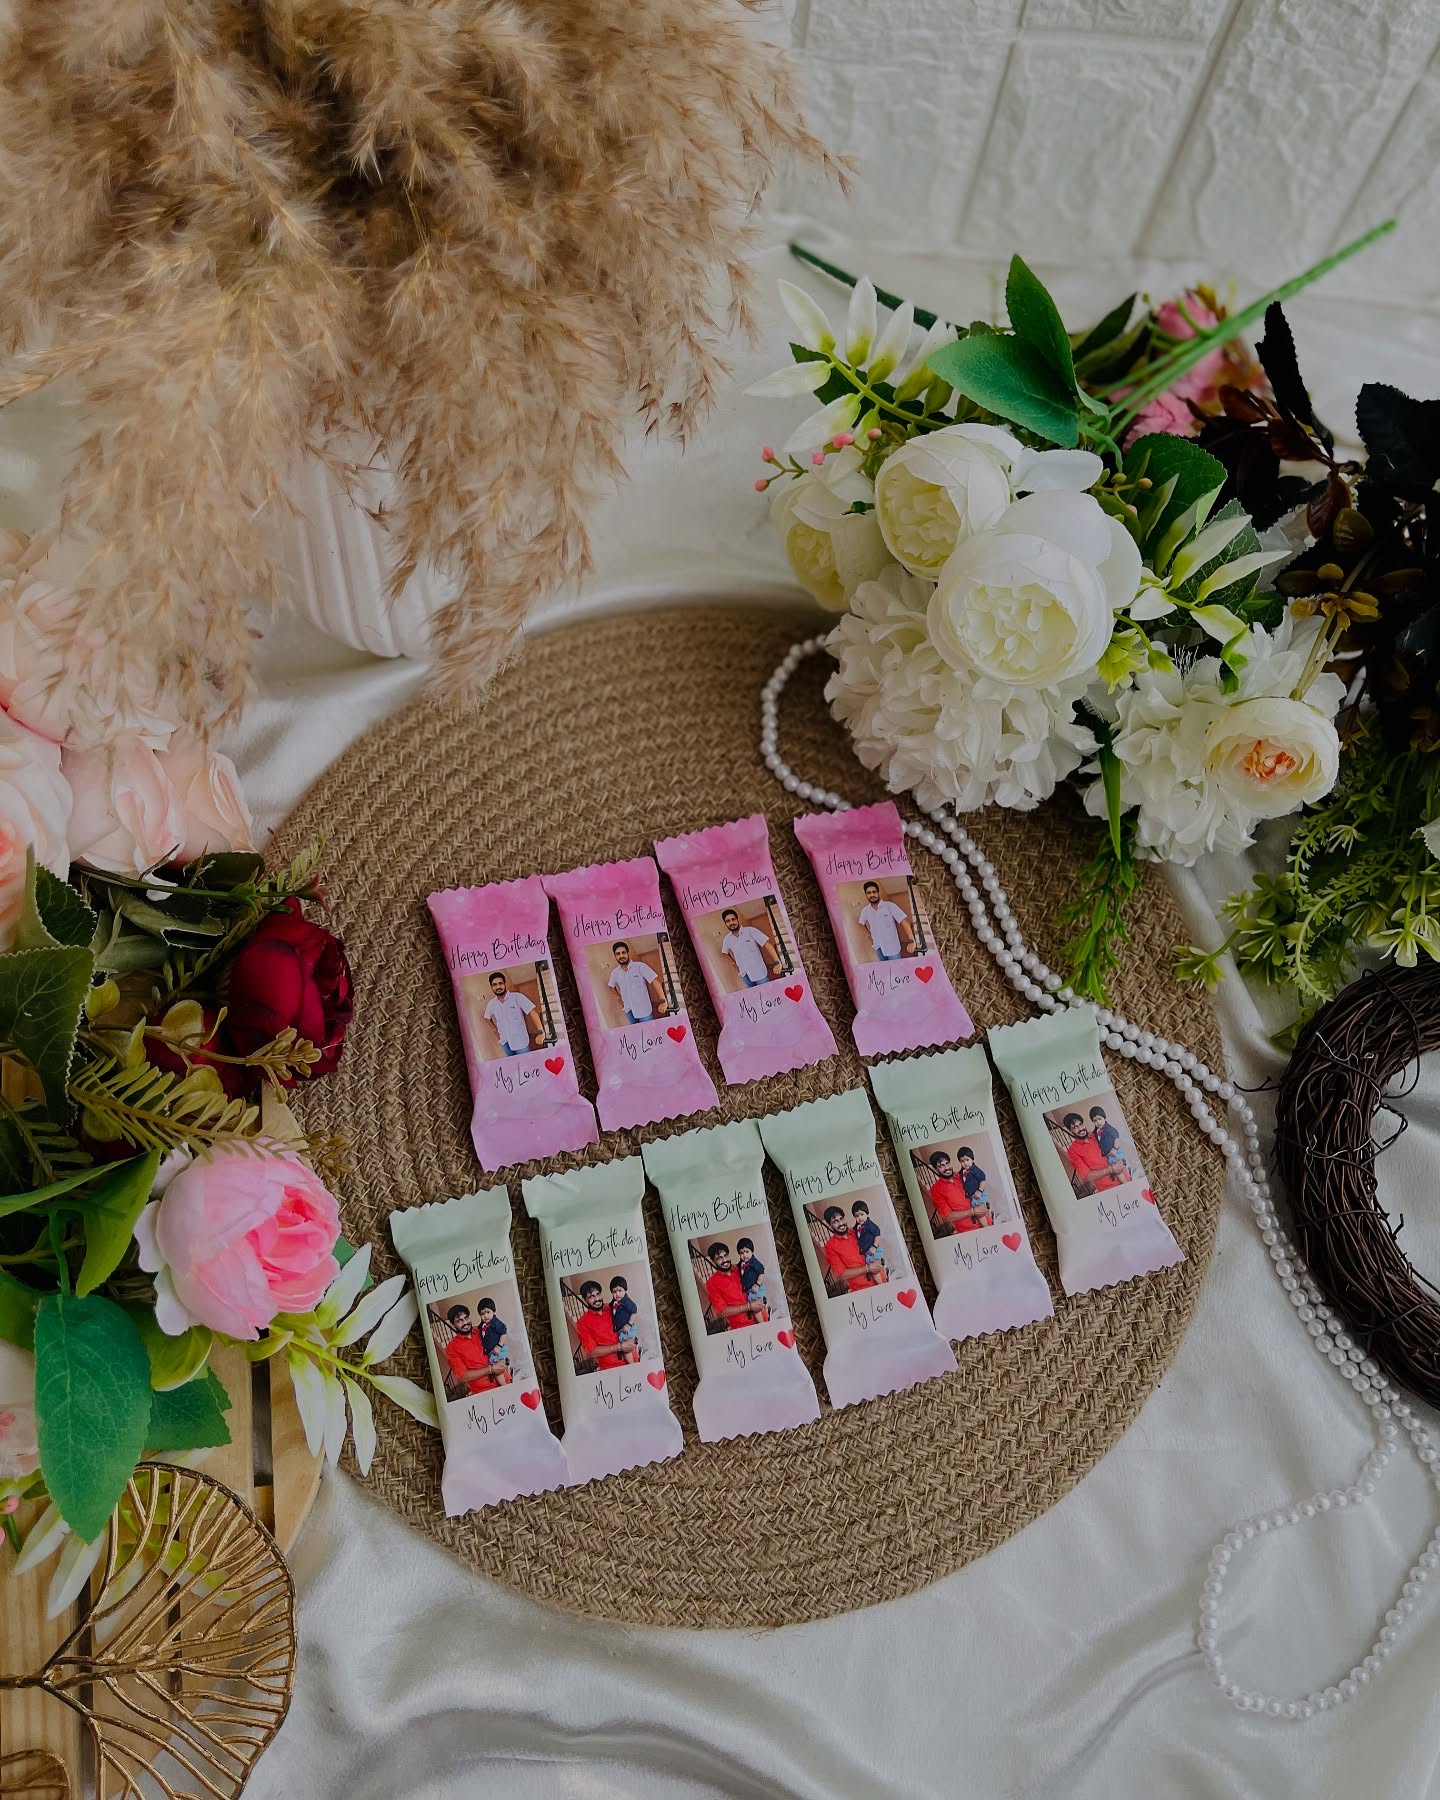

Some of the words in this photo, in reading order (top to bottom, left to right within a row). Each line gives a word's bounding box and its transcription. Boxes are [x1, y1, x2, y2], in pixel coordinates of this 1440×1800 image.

[826, 854, 862, 875] Happy
[682, 886, 719, 909] Happy
[720, 870, 771, 897] Birthday
[574, 914, 611, 937] Happy
[615, 904, 665, 929] Birthday
[450, 945, 488, 969] Happy
[492, 933, 545, 960] Birthday
[868, 970, 884, 995] My
[890, 968, 910, 990] Love
[739, 998, 757, 1022] My
[760, 992, 782, 1014] Love
[619, 1034, 637, 1060] My
[642, 1028, 664, 1053] Love
[495, 1067, 513, 1093] My
[518, 1062, 540, 1086] Love
[1022, 1082, 1059, 1107] Happy
[893, 1117, 928, 1144] Happy
[931, 1105, 984, 1132] Birthday
[825, 1154, 879, 1185] Birthday
[669, 1204, 709, 1232] Happy
[712, 1190, 767, 1222] Birthday
[1098, 1200, 1116, 1227] My
[1117, 1194, 1139, 1219] Love
[587, 1226, 643, 1259] Birthday
[954, 1242, 972, 1269] My
[976, 1237, 998, 1262] Love
[453, 1249, 510, 1283] Birthday
[849, 1302, 867, 1330] My
[870, 1295, 893, 1322] Love
[727, 1340, 745, 1368] My
[750, 1333, 773, 1360] Love
[594, 1380, 614, 1409] My
[619, 1376, 642, 1402] Love
[468, 1405, 487, 1433] My
[492, 1397, 516, 1425] Love
